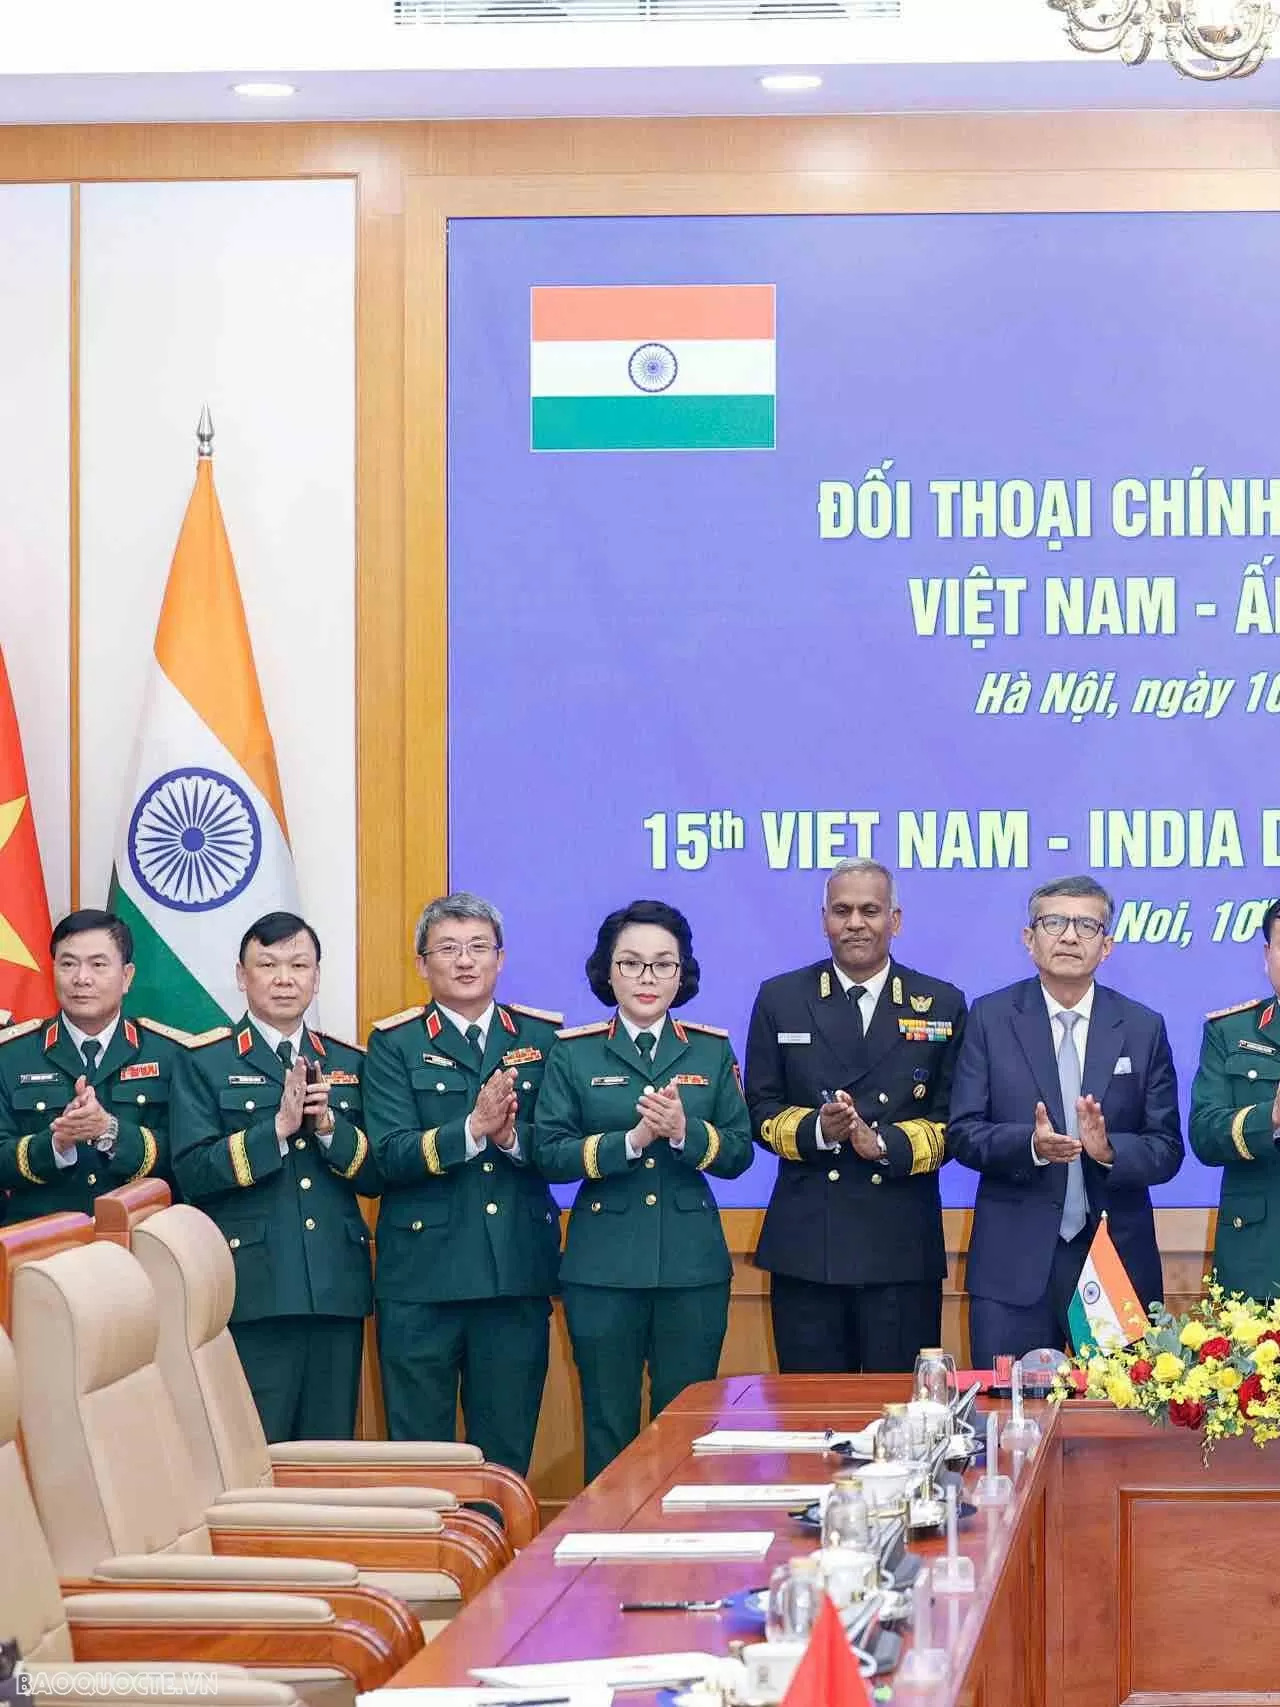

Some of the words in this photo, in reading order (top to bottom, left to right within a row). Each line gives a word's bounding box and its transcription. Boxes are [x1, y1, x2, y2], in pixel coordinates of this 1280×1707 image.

[817, 458, 912, 540] ĐỐI
[929, 478, 1092, 551] THOẠI
[908, 565, 1027, 650] VIỆT
[1045, 576, 1177, 636] NAM
[1194, 603, 1217, 617] -
[975, 671, 1031, 714] Hà
[1038, 671, 1120, 724] Nội,
[1132, 671, 1235, 718] ngày
[644, 809, 745, 871] 15th
[761, 811, 881, 870] VIET
[898, 810, 1029, 869] NAM
[1047, 836, 1069, 850] -
[1088, 809, 1245, 869] INDIA
[1113, 901, 1194, 947] Noi,
